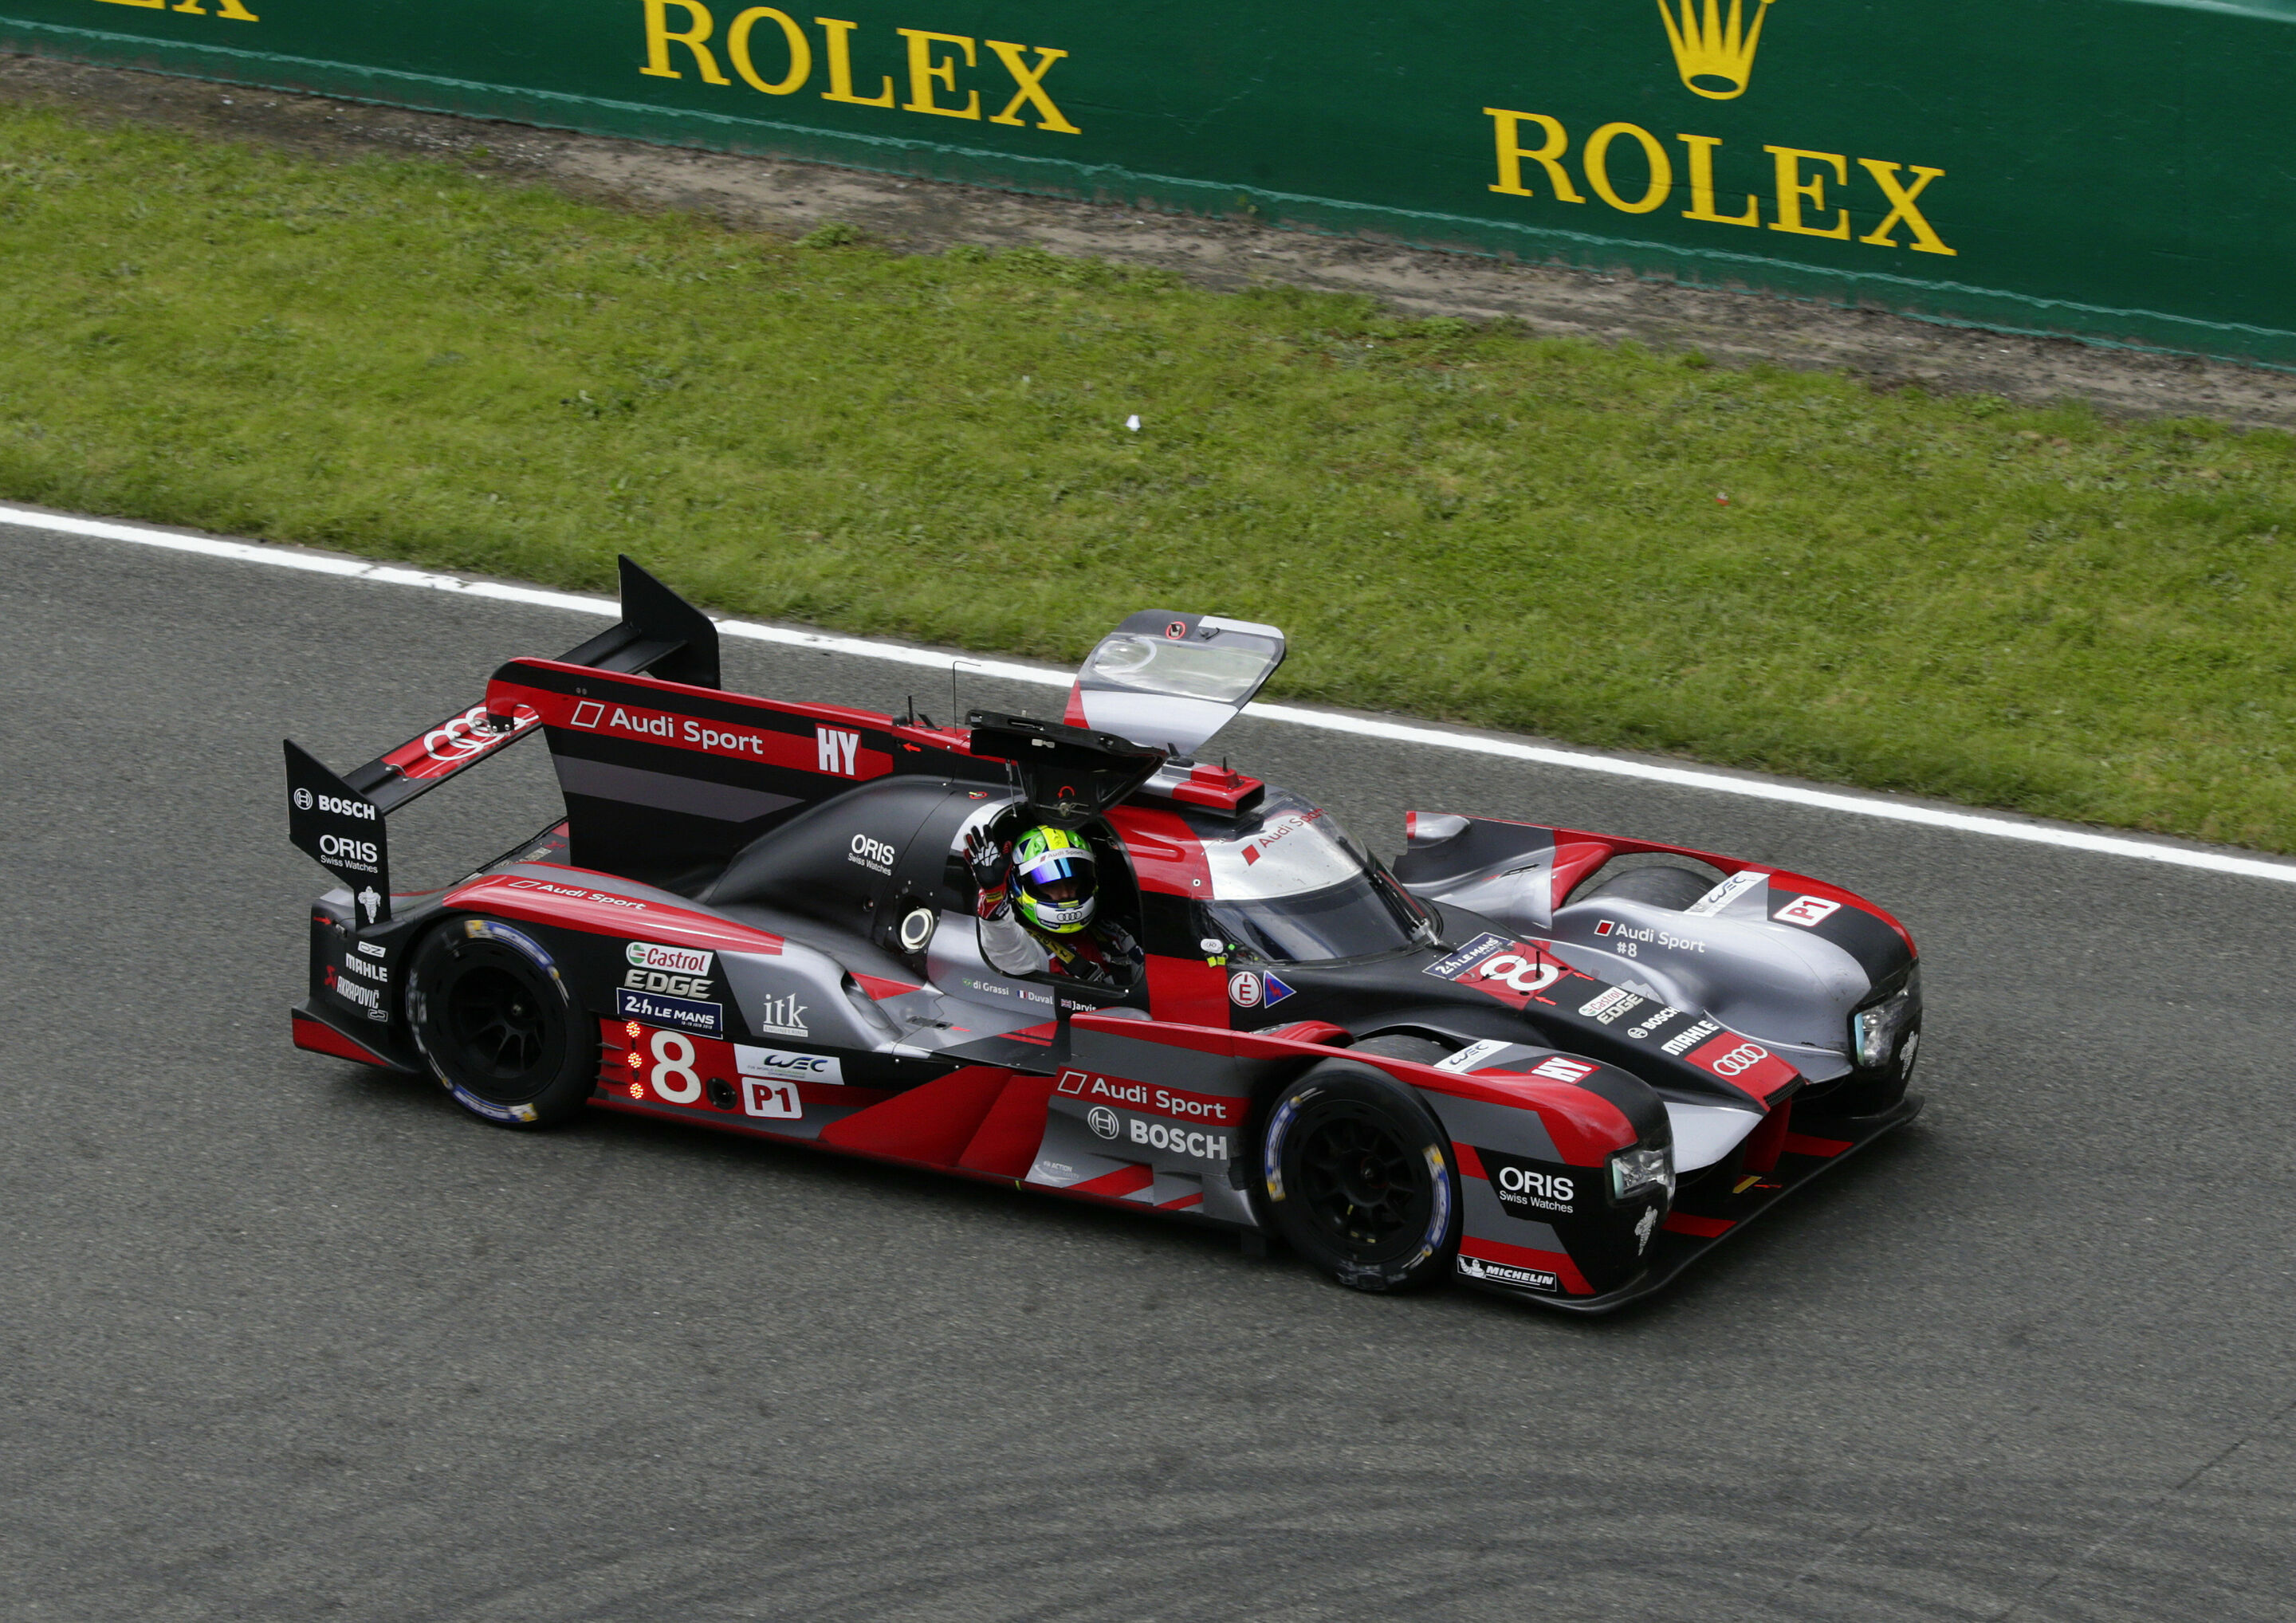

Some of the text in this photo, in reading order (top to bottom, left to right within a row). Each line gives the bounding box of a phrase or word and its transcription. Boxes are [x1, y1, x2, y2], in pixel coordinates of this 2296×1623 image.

[639, 0, 1082, 134] ROLEX
[1483, 107, 1957, 256] ROLEX
[610, 707, 763, 755] Audi Sport
[817, 727, 859, 776] HY
[318, 795, 375, 820] BOSCH
[320, 834, 378, 863] ORIS
[851, 834, 895, 866] ORIS
[1259, 824, 1293, 848] Audi
[320, 855, 378, 873] Swiss Watches
[848, 852, 891, 876] Swiss Watches
[537, 885, 646, 910] Audi Sport
[1786, 901, 1830, 920] P1
[360, 943, 382, 955] OZ
[1615, 923, 1705, 953] Audi Sport
[1617, 941, 1637, 957] #8
[346, 953, 387, 982] MAHLE
[647, 948, 706, 972] Castrol
[1480, 955, 1559, 991] 8
[337, 976, 379, 1009] AKRAPOVIČ
[624, 969, 714, 999] EDGE
[973, 980, 1009, 996] di Grassi
[1028, 992, 1053, 1004] Duval
[763, 992, 808, 1028] itk
[1590, 987, 1623, 1011] Castrol
[1596, 993, 1644, 1025] EDGE
[654, 1007, 672, 1019] LE
[674, 1010, 714, 1025] MANS
[1641, 1006, 1681, 1030] BOSCH
[1661, 1020, 1720, 1055] MAHLE
[650, 1030, 702, 1104] 8
[764, 1055, 828, 1072] WEC
[1531, 1058, 1593, 1083] HY
[752, 1084, 792, 1112] P1
[1091, 1077, 1227, 1119] Audi Sport
[1130, 1118, 1227, 1161] BOSCH
[1499, 1166, 1574, 1201] ORIS
[1499, 1190, 1574, 1213] Swiss Watches
[1486, 1265, 1555, 1286] MICHELIN
